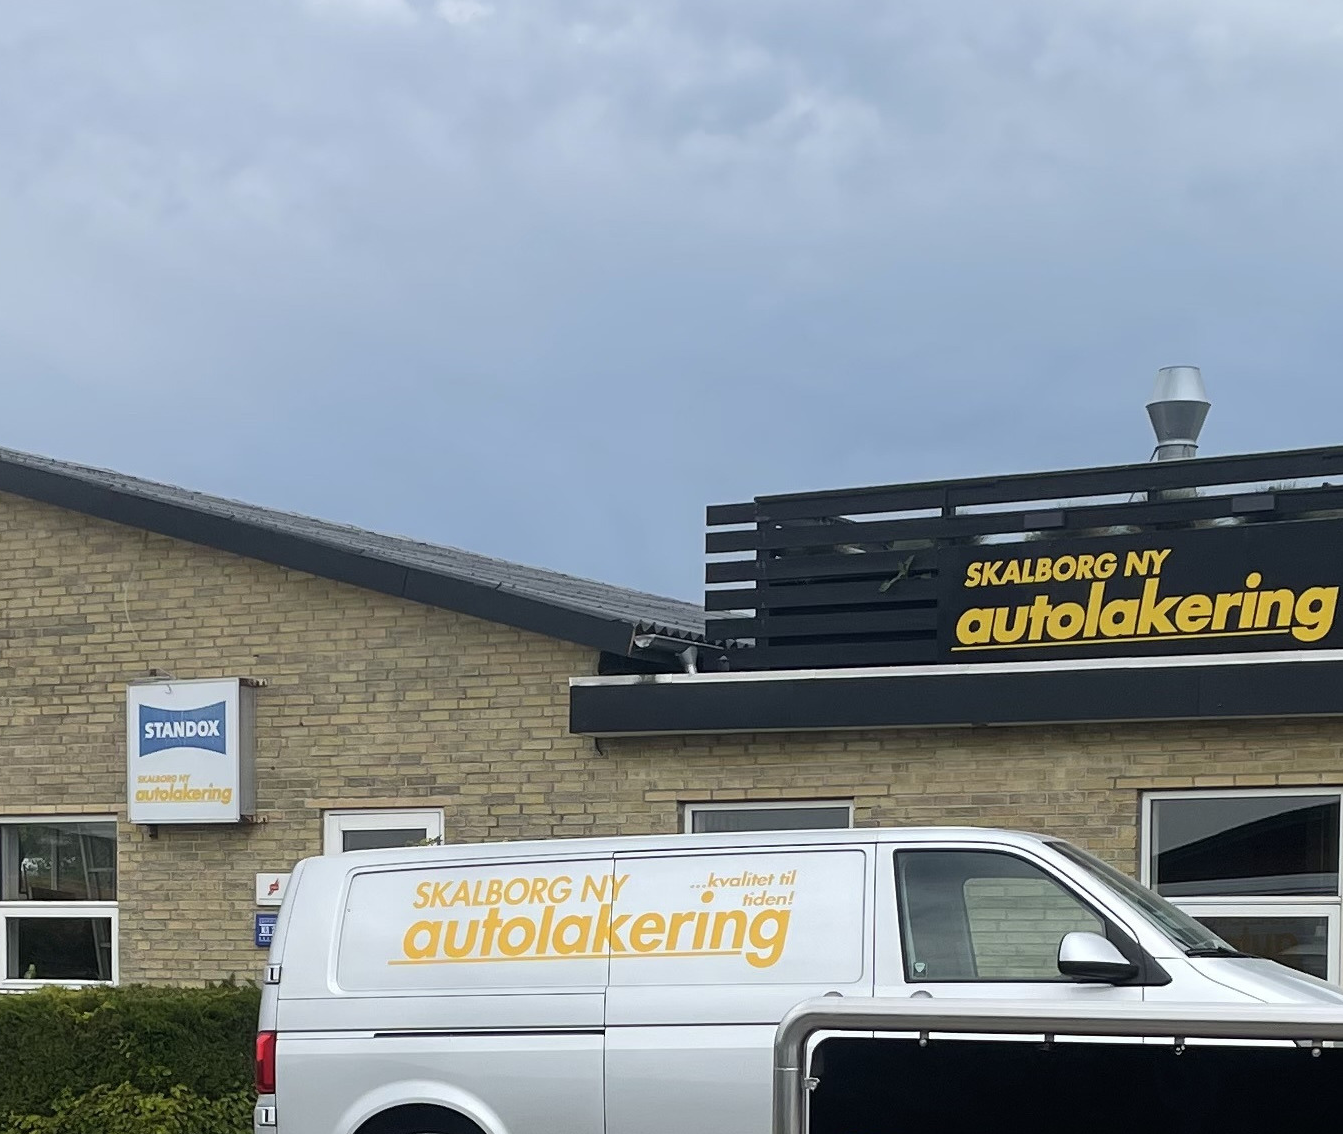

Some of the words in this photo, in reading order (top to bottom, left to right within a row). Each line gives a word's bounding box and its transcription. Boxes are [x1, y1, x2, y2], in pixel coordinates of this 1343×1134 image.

[964, 552, 1118, 588] SKALBORG
[1123, 548, 1173, 577] NY
[954, 572, 1341, 643] autolakering
[144, 719, 221, 739] STANDOX
[136, 774, 178, 784] SKALBORG
[178, 773, 191, 783] NY
[135, 782, 233, 806] autolakering
[776, 869, 797, 887] til
[413, 875, 572, 909] SKALBORG
[580, 874, 631, 903] NY
[742, 890, 795, 908] tiden!
[402, 891, 791, 969] autolakering
